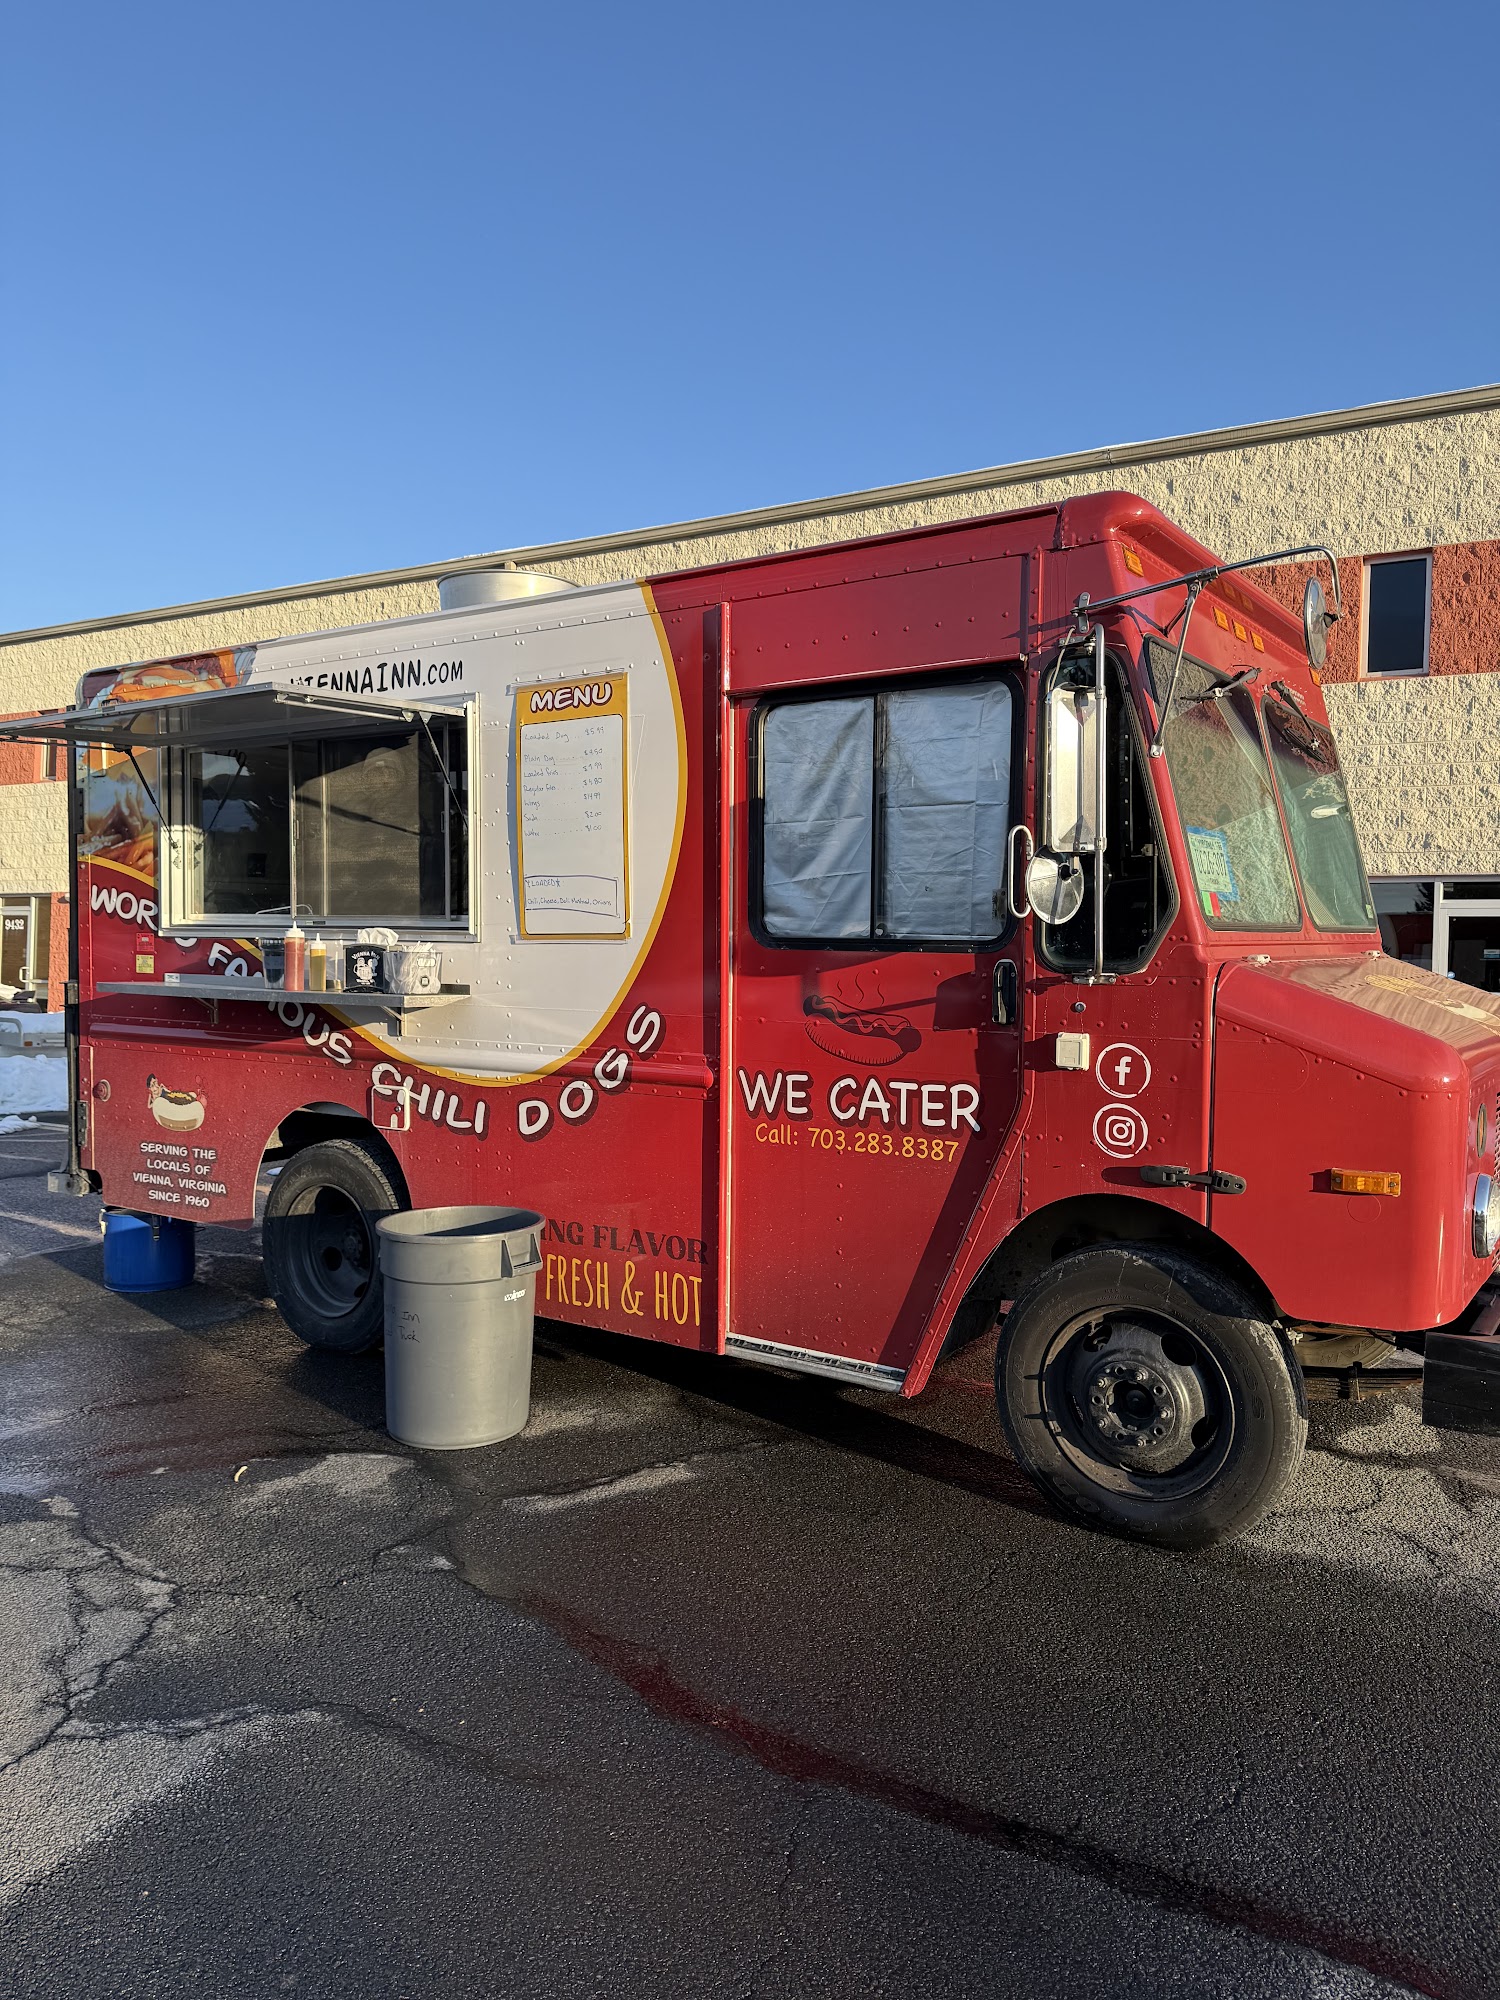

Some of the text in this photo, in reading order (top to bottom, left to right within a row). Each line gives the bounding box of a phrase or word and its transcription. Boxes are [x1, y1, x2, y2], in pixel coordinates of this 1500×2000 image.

[530, 682, 612, 713] MENU
[5, 918, 25, 930] 9432
[371, 1063, 486, 1134] CHILI
[518, 1005, 661, 1135] DOGS
[738, 1069, 981, 1132] WE CATER
[140, 1142, 217, 1160] SERVING THE
[755, 1122, 959, 1162] Call: 703.283.8387
[146, 1158, 211, 1175] LOCALS OF
[132, 1172, 227, 1195] VIENNA, VIRGINIA
[148, 1189, 210, 1208] SINCE 1960
[592, 1224, 709, 1265] FLAVOR
[545, 1253, 703, 1327] FRESH & HOT
